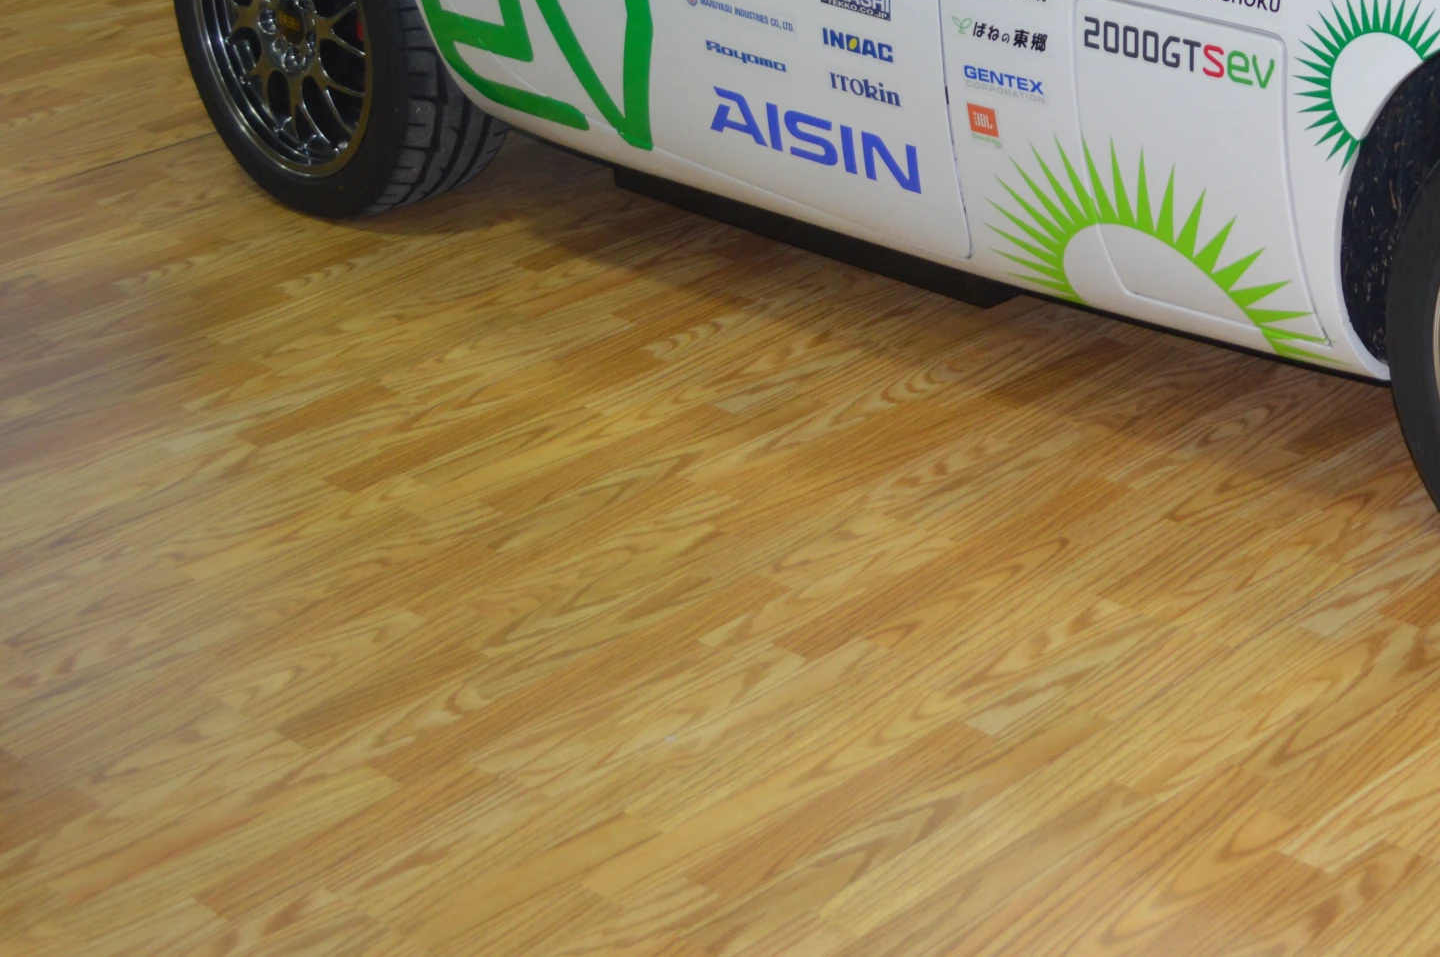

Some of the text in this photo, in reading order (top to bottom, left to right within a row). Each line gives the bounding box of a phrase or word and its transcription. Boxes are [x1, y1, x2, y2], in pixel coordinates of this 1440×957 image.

[733, 7, 770, 25] INDUSTRIES
[782, 21, 795, 32] LTD.
[822, 27, 894, 63] INOAC
[972, 21, 1048, 53] ばねの東郷
[1084, 15, 1276, 89] 2000GTSev
[963, 64, 1044, 95] GENTEX
[965, 79, 1046, 104] CORPORATION
[972, 111, 994, 129] JBL
[710, 86, 922, 194] AISIN
